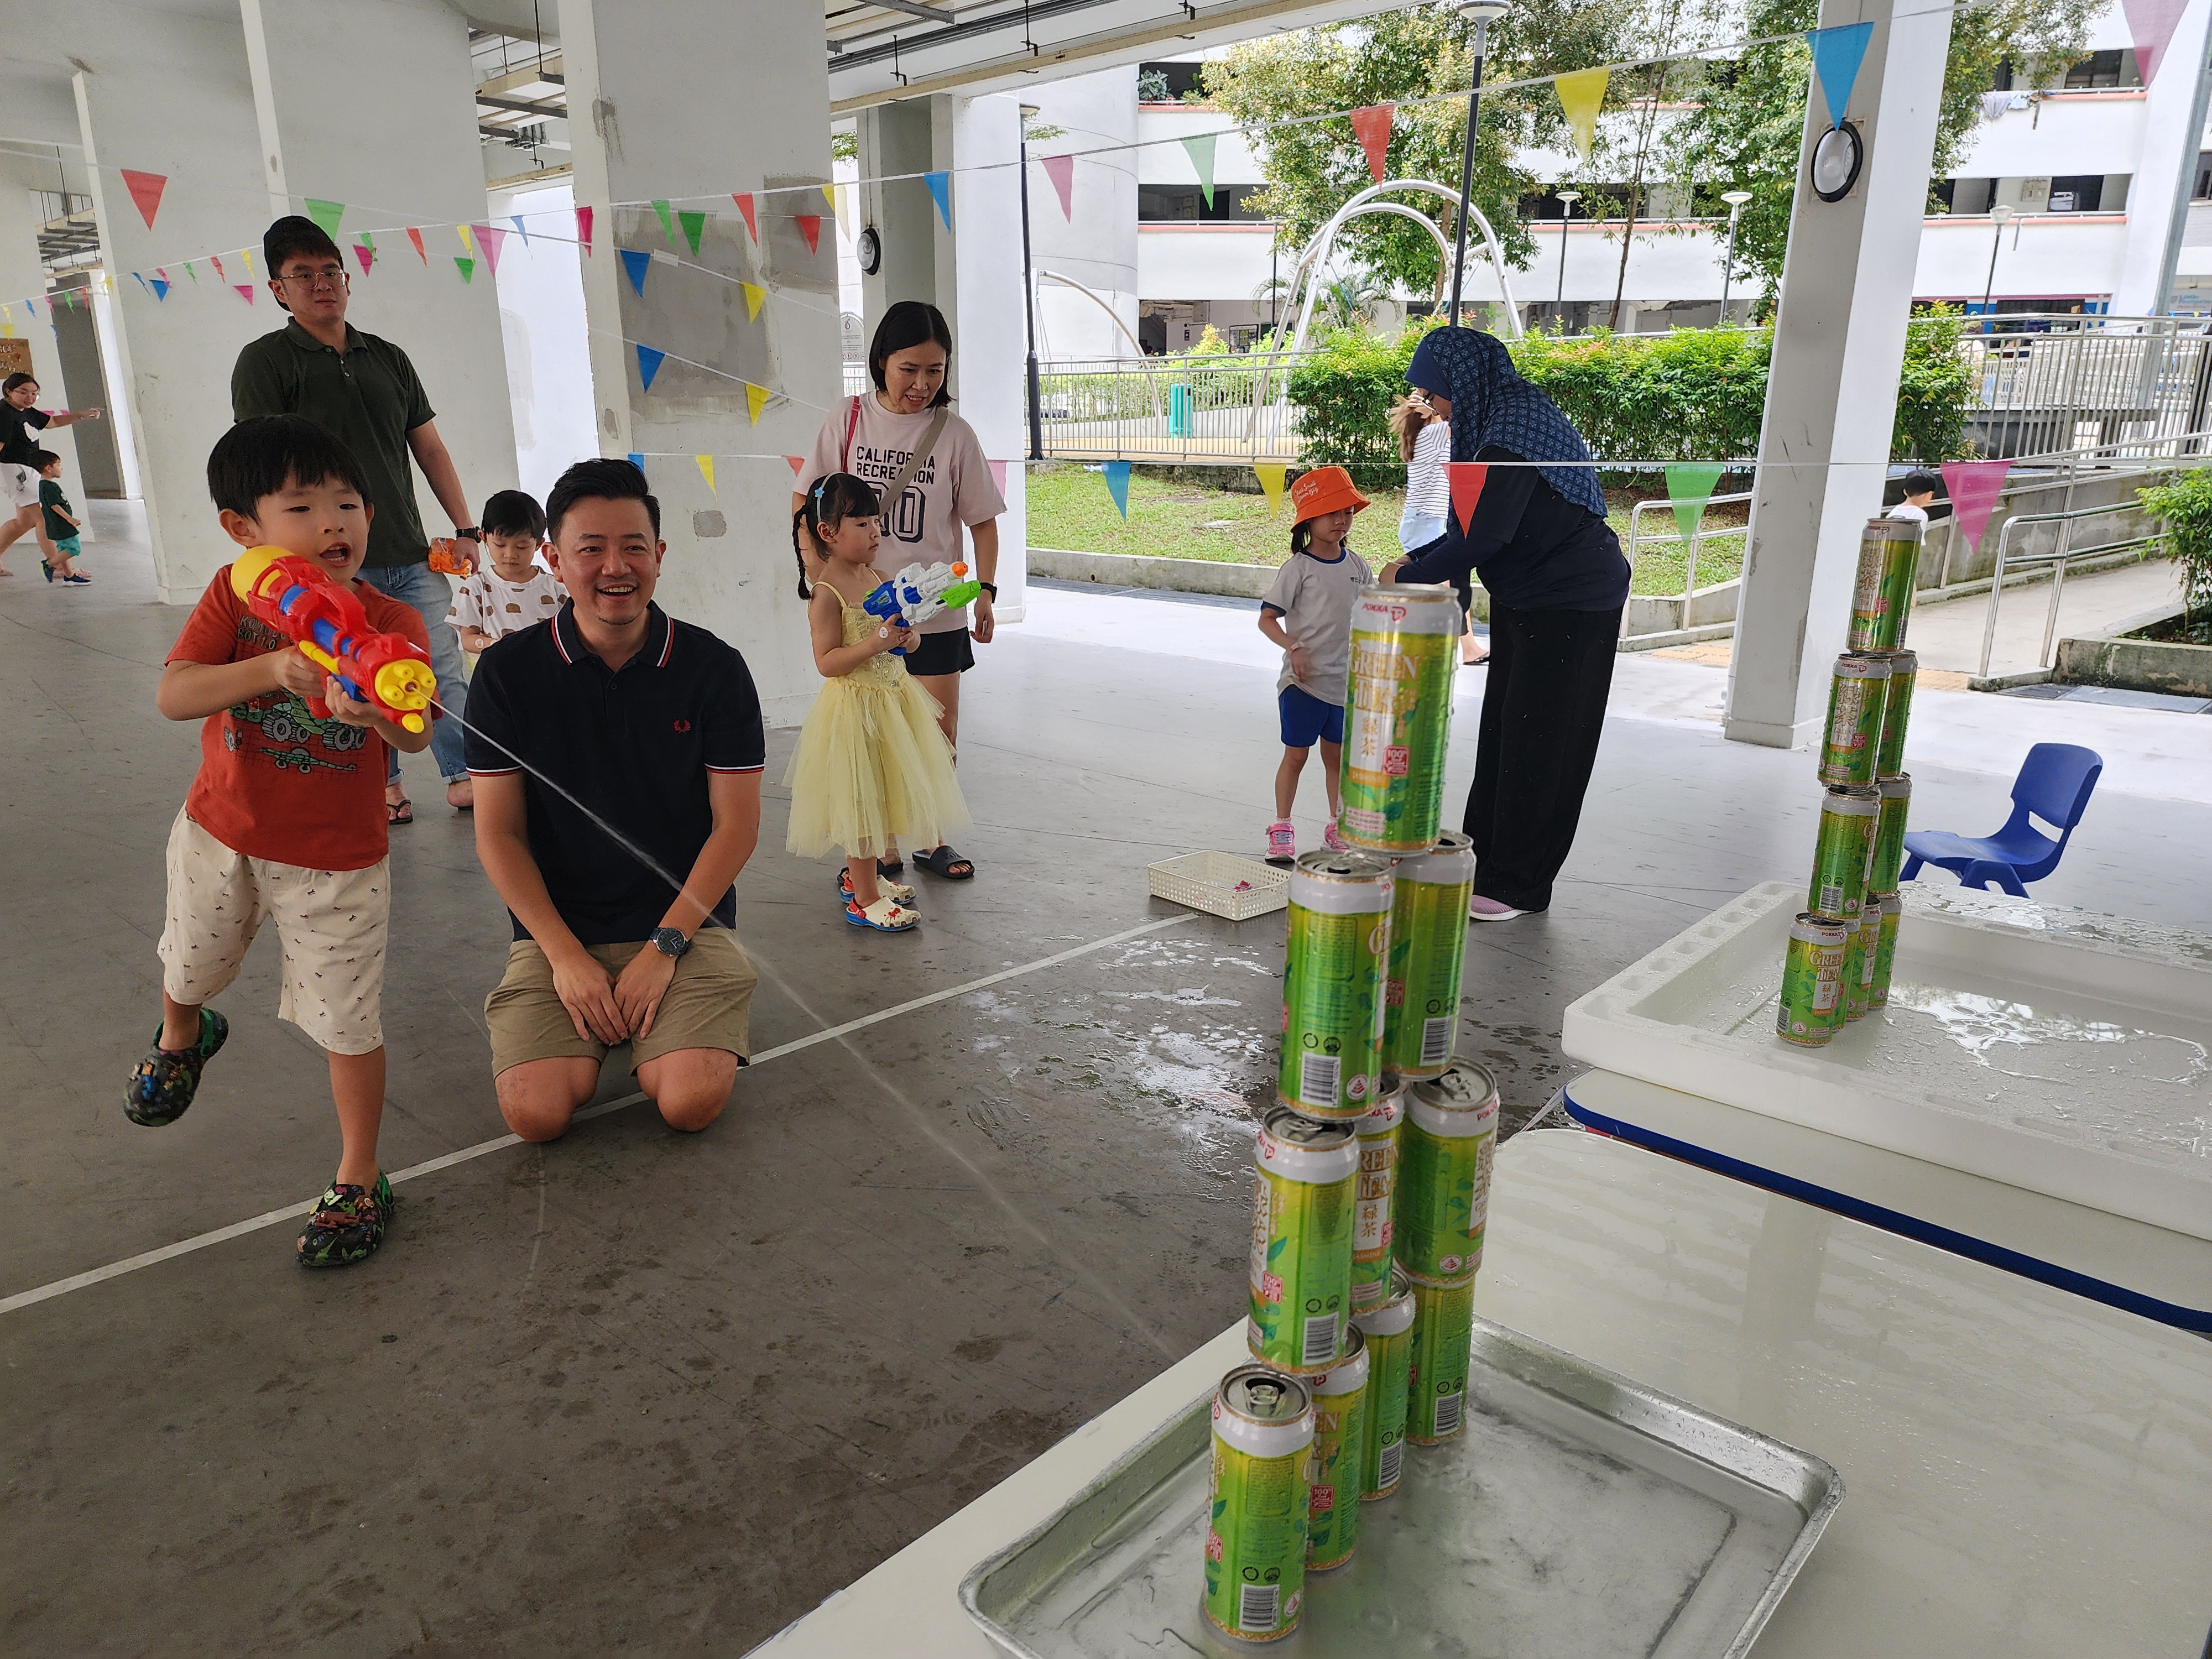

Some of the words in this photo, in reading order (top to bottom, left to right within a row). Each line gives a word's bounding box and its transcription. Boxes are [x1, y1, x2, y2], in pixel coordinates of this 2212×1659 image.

[857, 446, 935, 469] CALIFORIA
[857, 462, 935, 485] RECREION
[1362, 603, 1388, 612] POKKA
[237, 627, 258, 644] BOT
[260, 636, 275, 650] 1.0
[1349, 643, 1422, 682] GREEN
